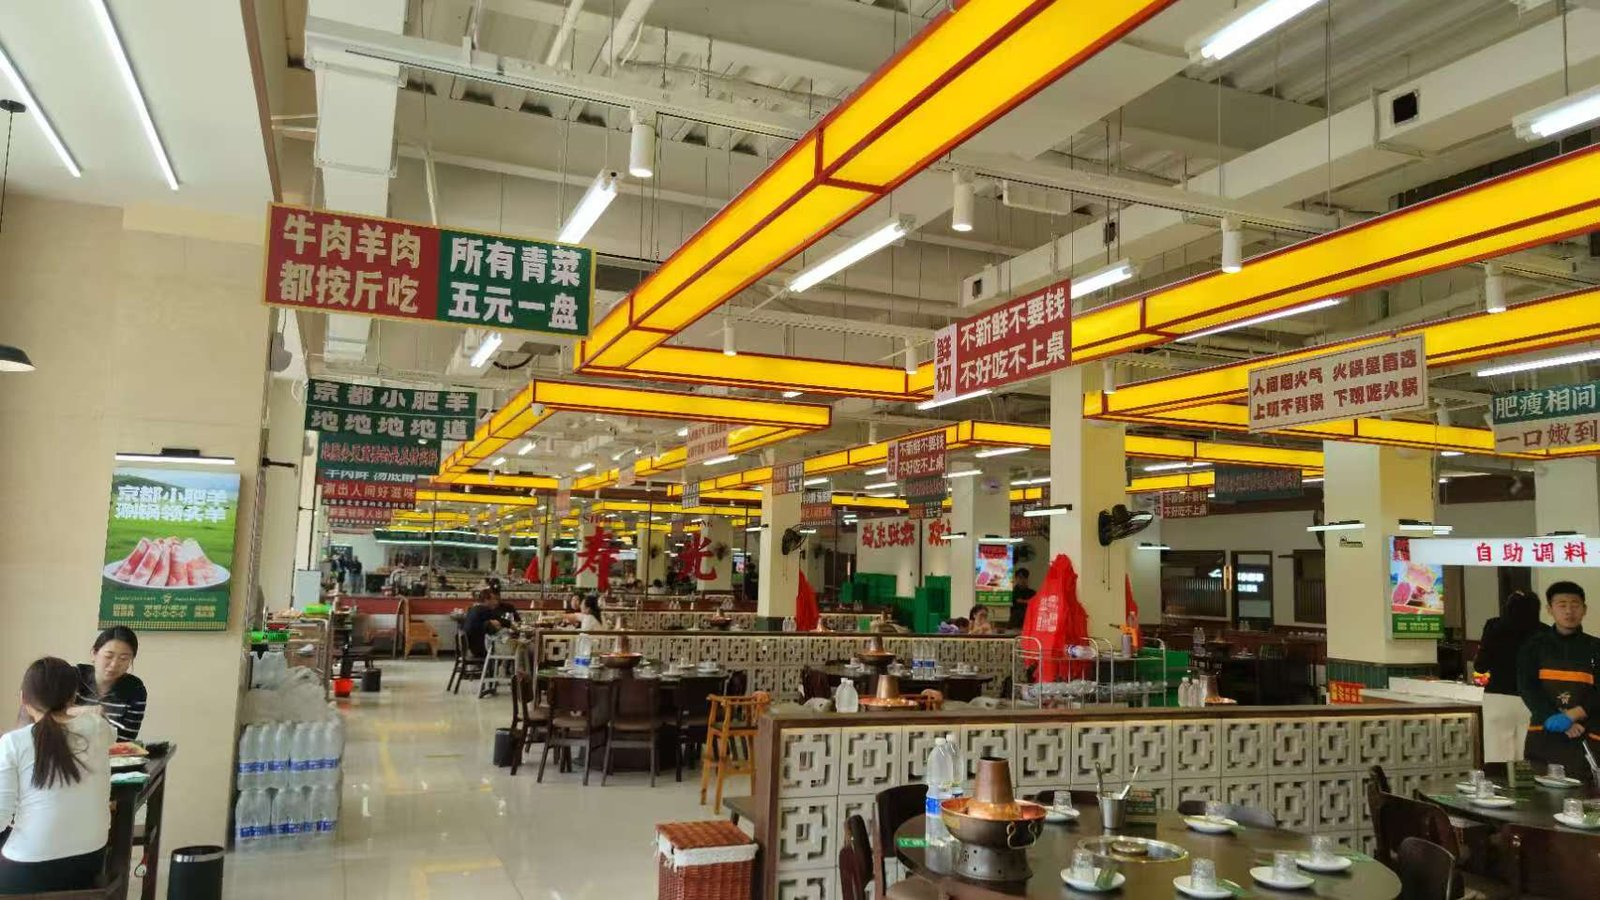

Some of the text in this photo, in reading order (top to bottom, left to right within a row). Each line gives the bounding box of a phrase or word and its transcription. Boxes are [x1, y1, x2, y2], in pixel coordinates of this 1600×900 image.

[283, 214, 421, 268] 牛肉羊肉
[450, 237, 581, 287] 所有青菜
[279, 260, 420, 314] 都按斤吃
[448, 282, 579, 330] 五元一盘
[960, 287, 1065, 352] 不新鲜不要钱
[936, 335, 951, 392] 鲜切
[960, 330, 1065, 389] 不好吃不上桌
[313, 382, 470, 412] 京都小肥羊
[1253, 367, 1323, 396] 人间烟火气
[1253, 377, 1418, 420] 上班不背锅 下班吃火锅
[1495, 384, 1596, 418] 肥瘦相间
[311, 411, 468, 439] 地地地地道
[1497, 420, 1598, 446] 一口嫩到
[900, 454, 944, 475] 不好吃不上桌
[117, 485, 228, 504] 京都小肥羊
[324, 482, 415, 499] 涮出人间好滋味
[115, 503, 227, 522] 涮锅领头羊
[1476, 542, 1588, 562] 自助调料
